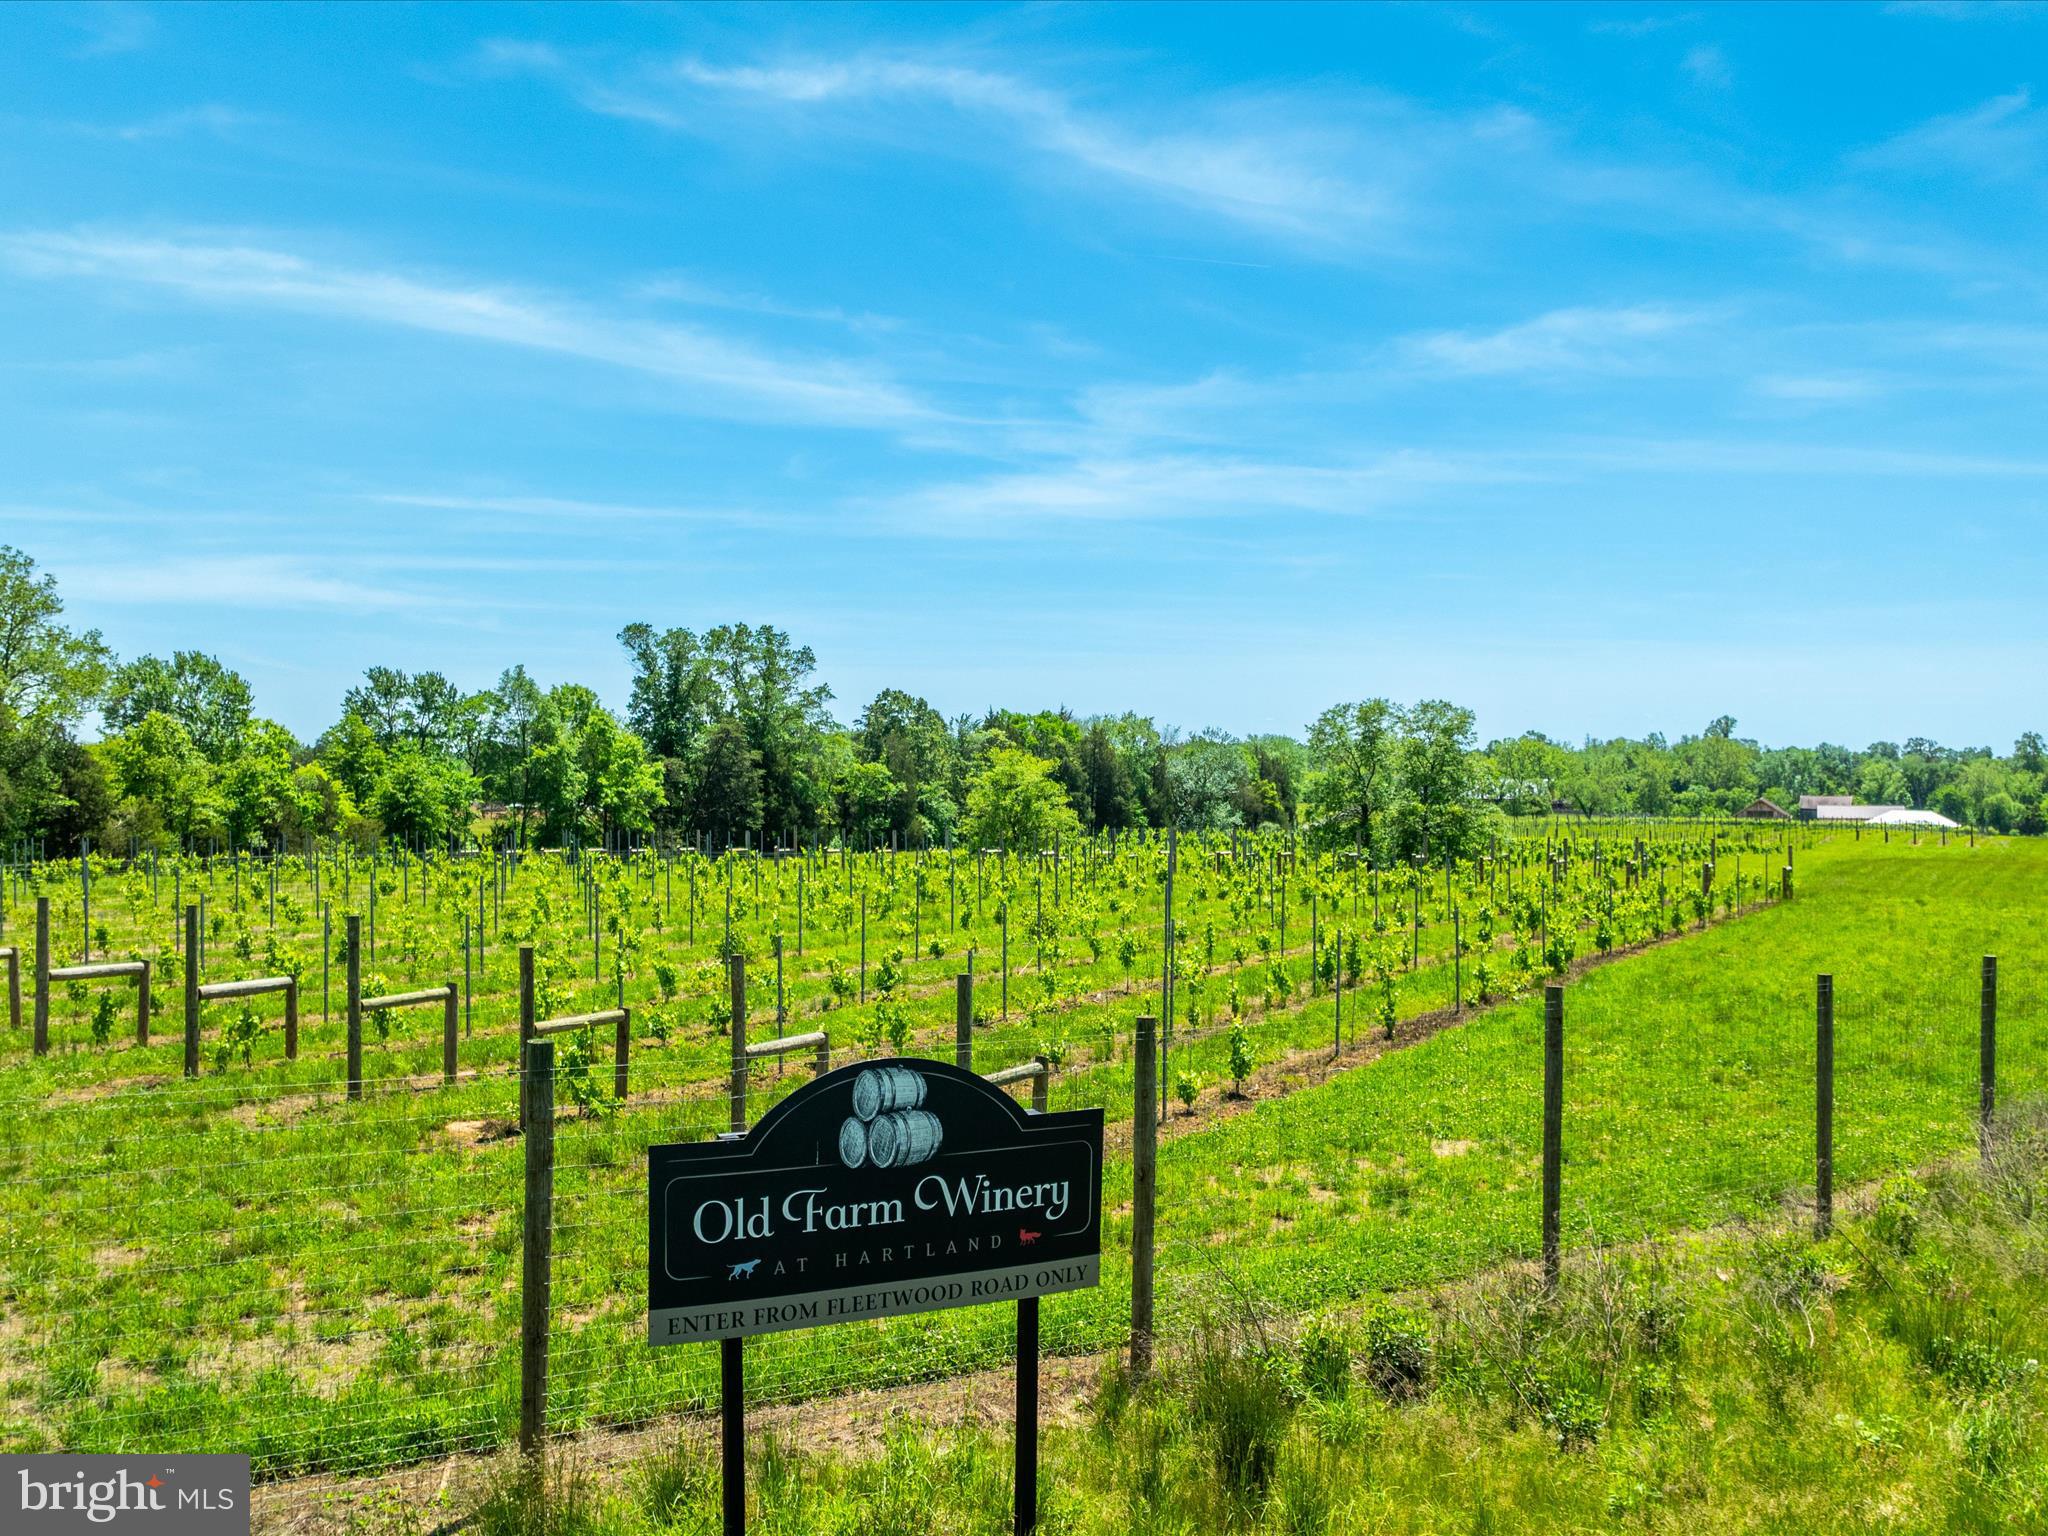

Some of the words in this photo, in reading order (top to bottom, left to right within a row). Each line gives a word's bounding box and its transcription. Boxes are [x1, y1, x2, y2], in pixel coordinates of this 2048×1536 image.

[693, 1197, 774, 1244] Old
[782, 1187, 905, 1233] Farm
[914, 1174, 1069, 1221] Winery
[774, 1258, 810, 1276] AT
[836, 1235, 1003, 1268] HARTLAND
[667, 1310, 745, 1336] ENTER
[753, 1301, 818, 1326] FROM
[827, 1283, 963, 1316] FLEETWOOD
[971, 1274, 1029, 1297] ROAD
[1036, 1264, 1089, 1288] ONLY
